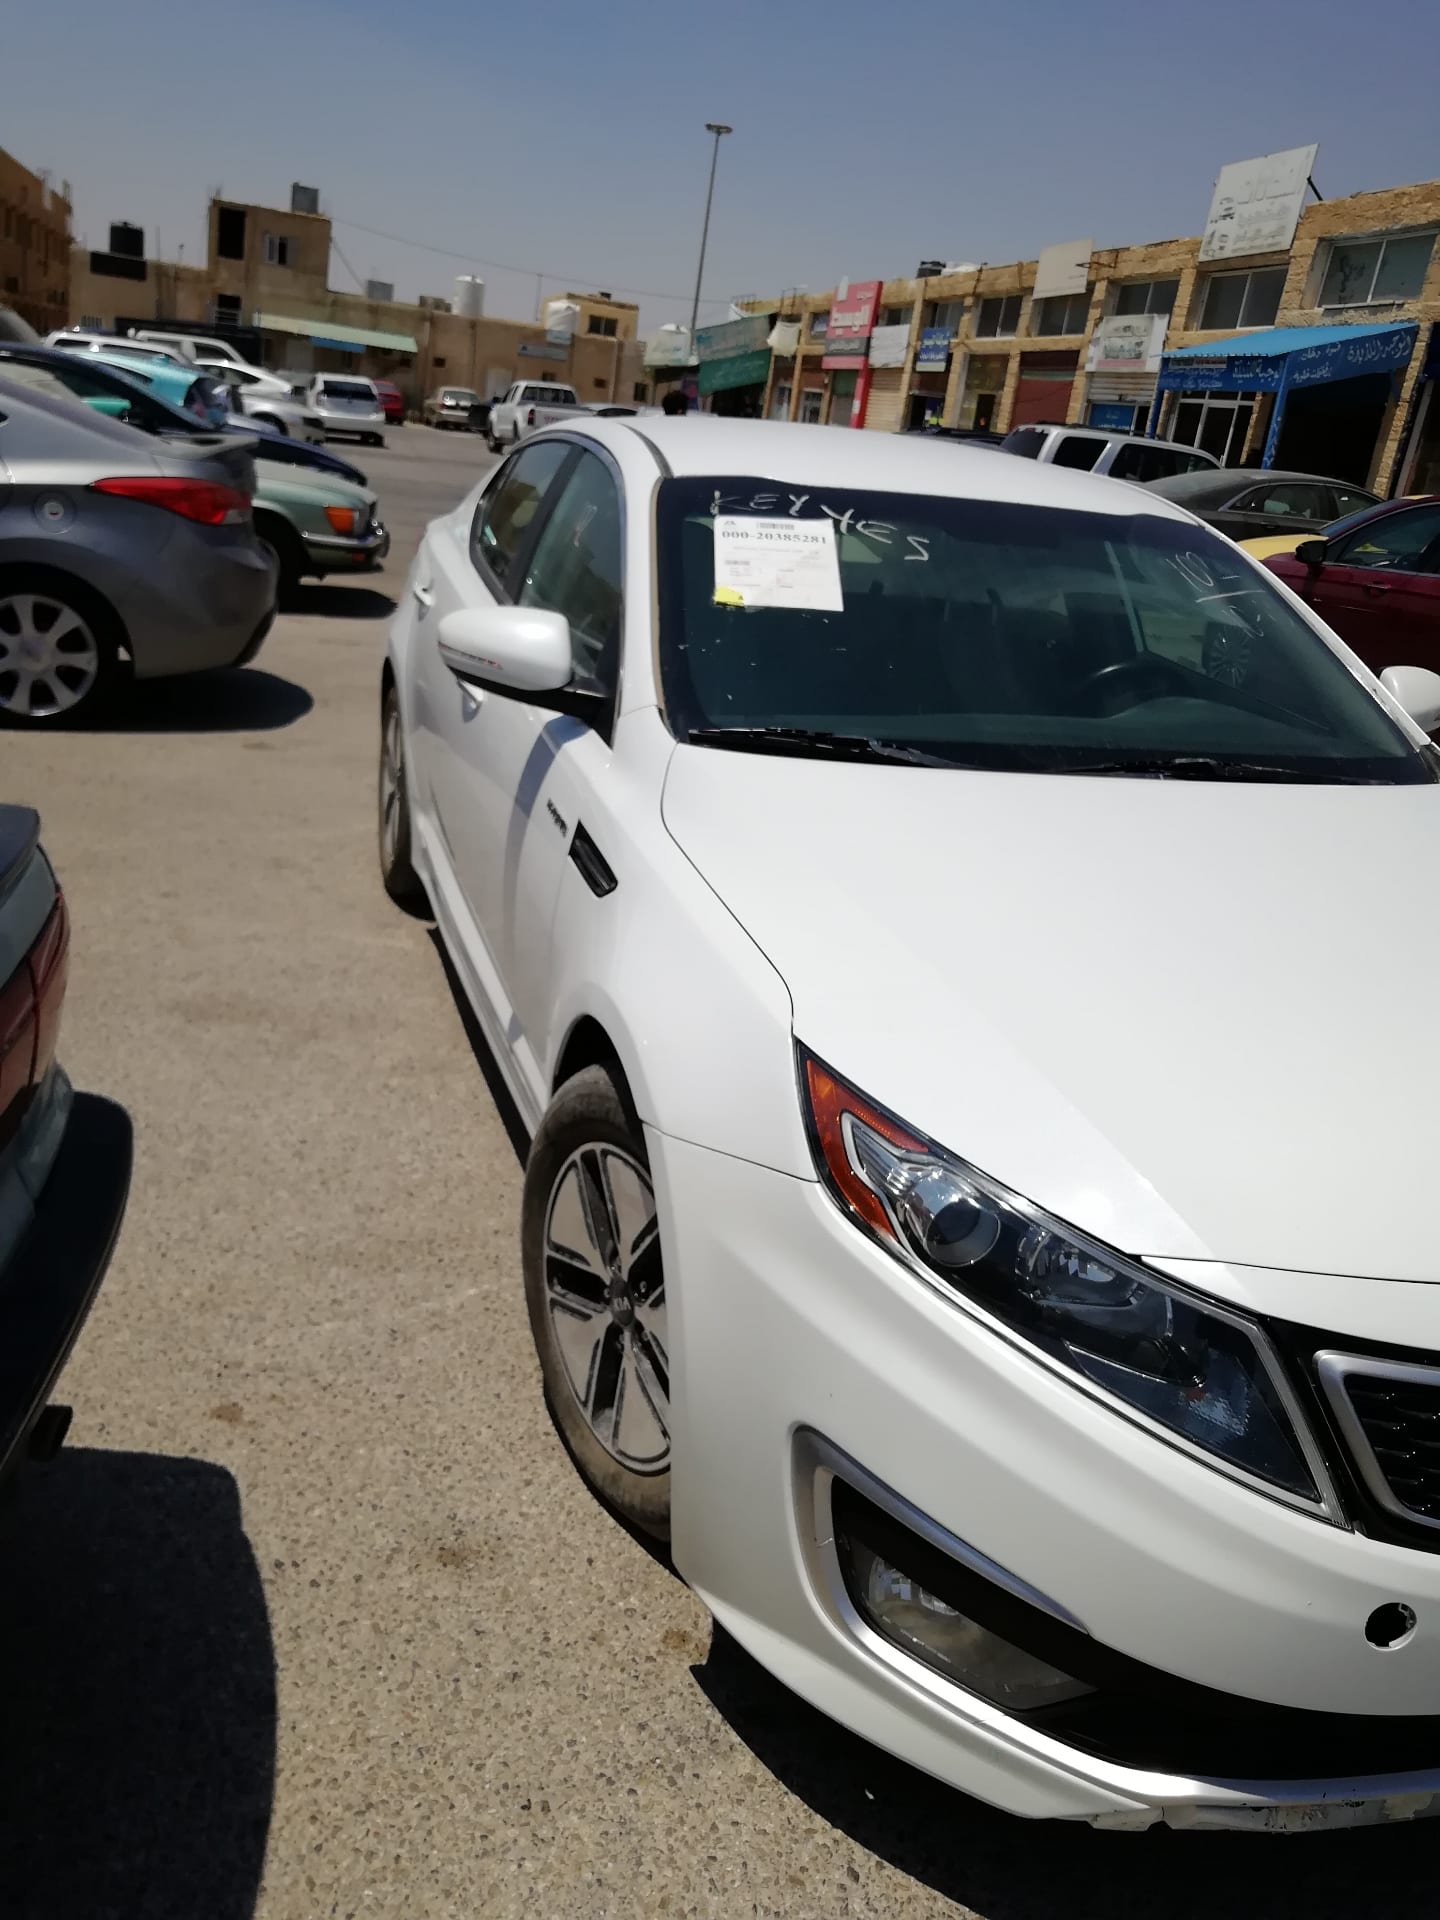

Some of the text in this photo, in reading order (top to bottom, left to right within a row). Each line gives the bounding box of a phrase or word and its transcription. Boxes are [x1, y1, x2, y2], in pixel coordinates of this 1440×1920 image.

[710, 490, 930, 561] KEY YES
[721, 530, 828, 545] 000-20385281
